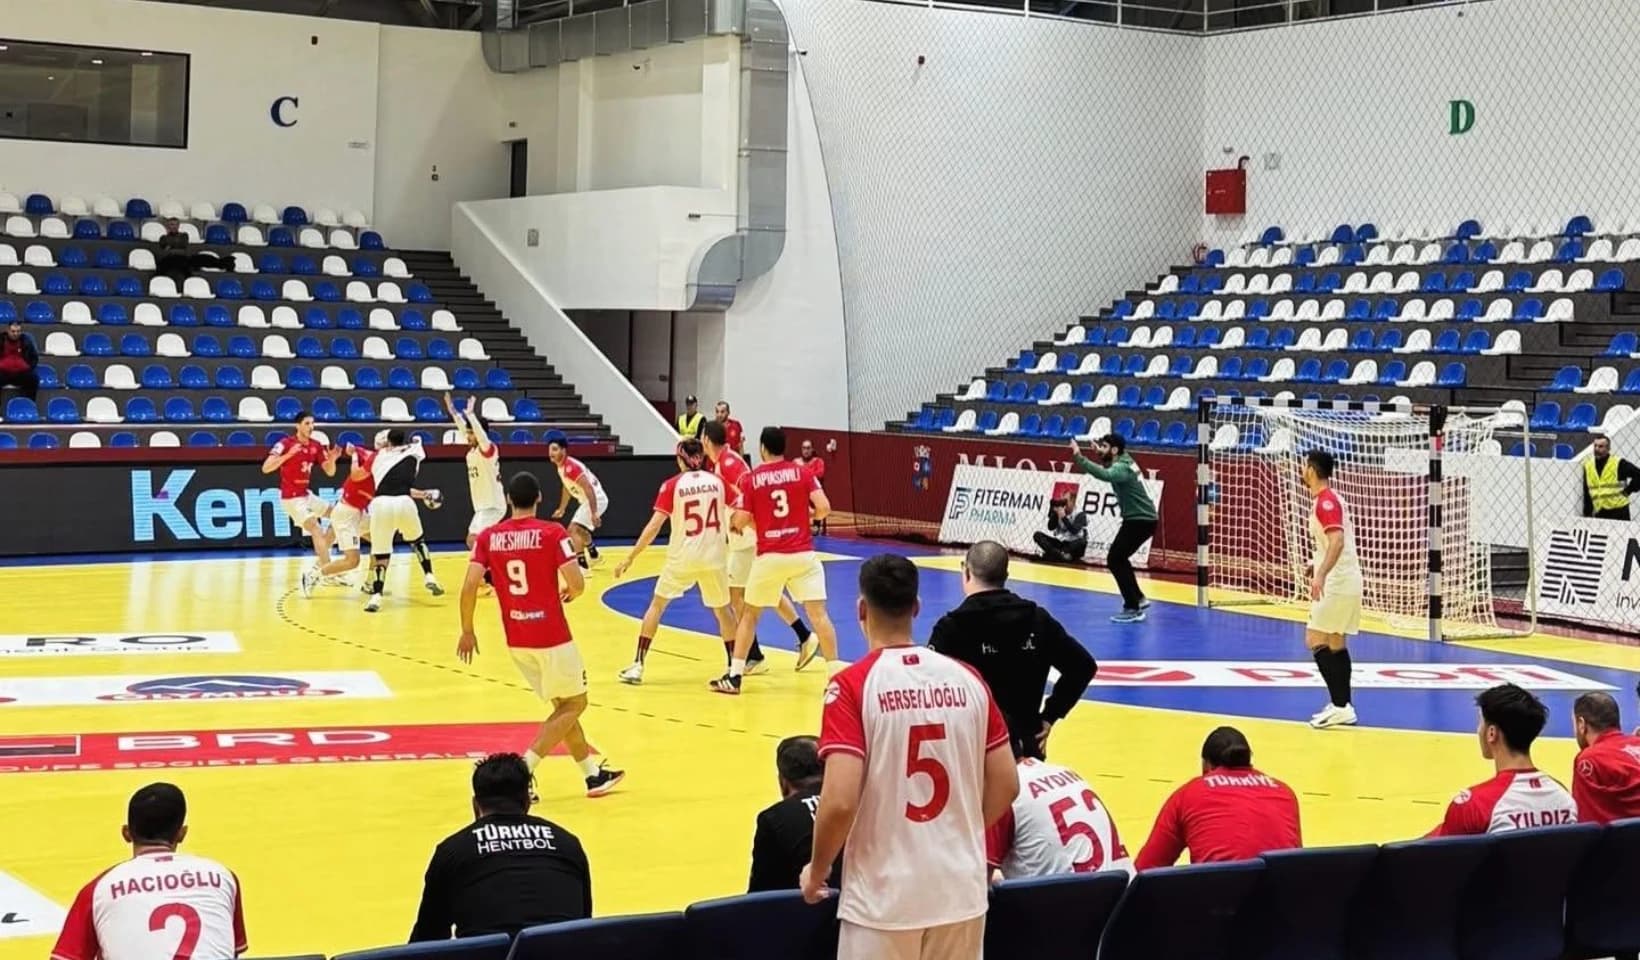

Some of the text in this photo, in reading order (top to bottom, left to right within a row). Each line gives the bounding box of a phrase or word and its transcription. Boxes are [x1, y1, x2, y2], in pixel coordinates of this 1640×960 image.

[270, 96, 298, 127] C
[1448, 100, 1475, 135] D
[679, 484, 718, 497] BABACAN
[770, 489, 789, 518] 3
[974, 488, 1044, 511] FITERMAN
[969, 508, 1017, 526] PHARMA
[1083, 491, 1119, 517] BR
[684, 498, 720, 537] 54
[489, 529, 543, 552] ARESHIDZE
[506, 559, 528, 596] 9
[118, 731, 392, 751] BRD
[905, 723, 950, 823] 5
[472, 824, 555, 841] TÜRKİYE
[1049, 789, 1129, 872] 52
[477, 838, 557, 854] HENTBOL
